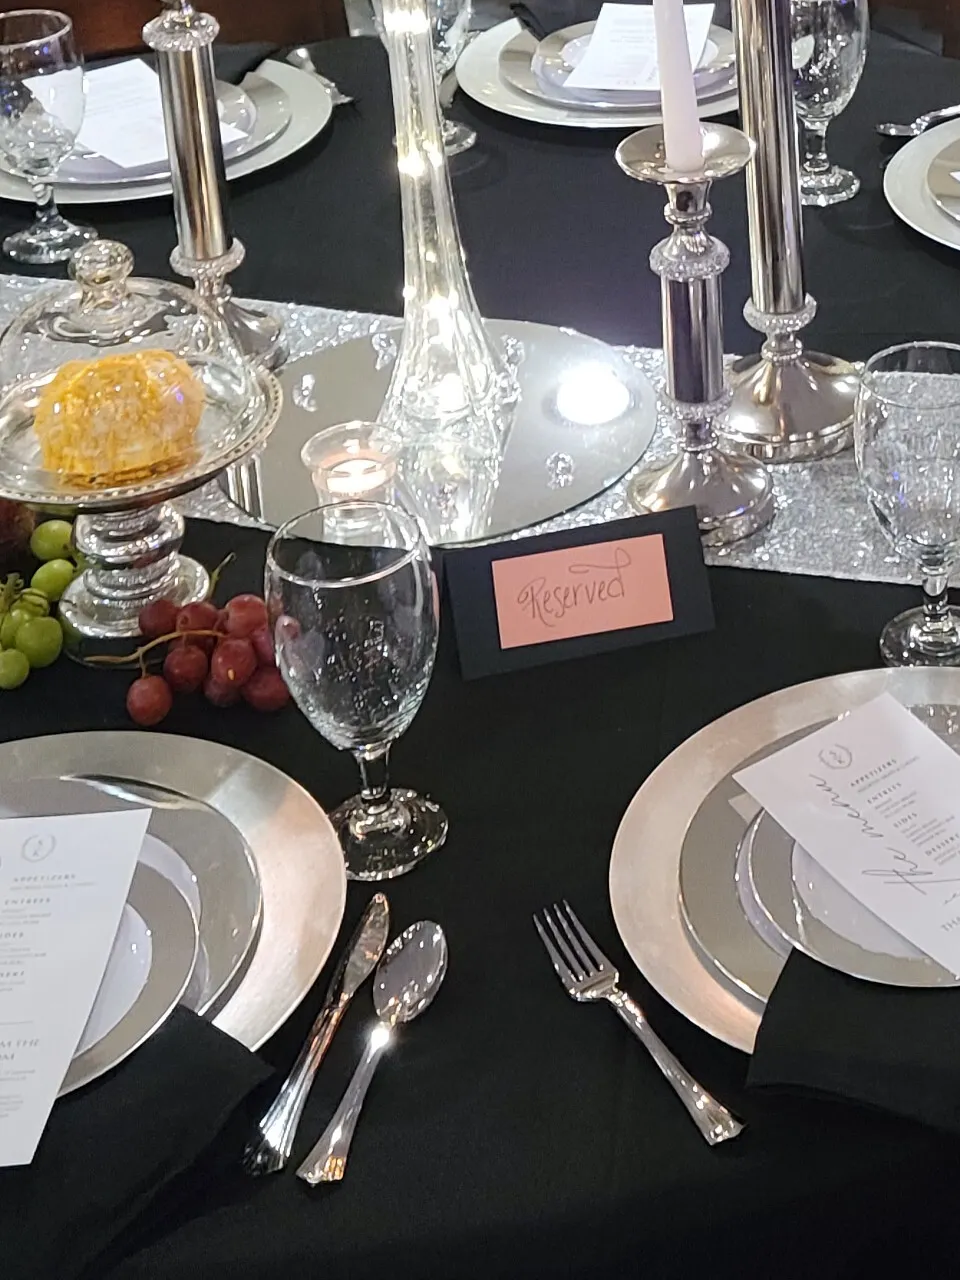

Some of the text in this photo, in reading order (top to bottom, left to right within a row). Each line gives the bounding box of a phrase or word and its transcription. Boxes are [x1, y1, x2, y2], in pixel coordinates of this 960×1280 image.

[517, 547, 632, 627] Reserved
[850, 758, 898, 788] APPETIZERS
[808, 773, 885, 838] menu
[924, 833, 960, 857] DESSERT
